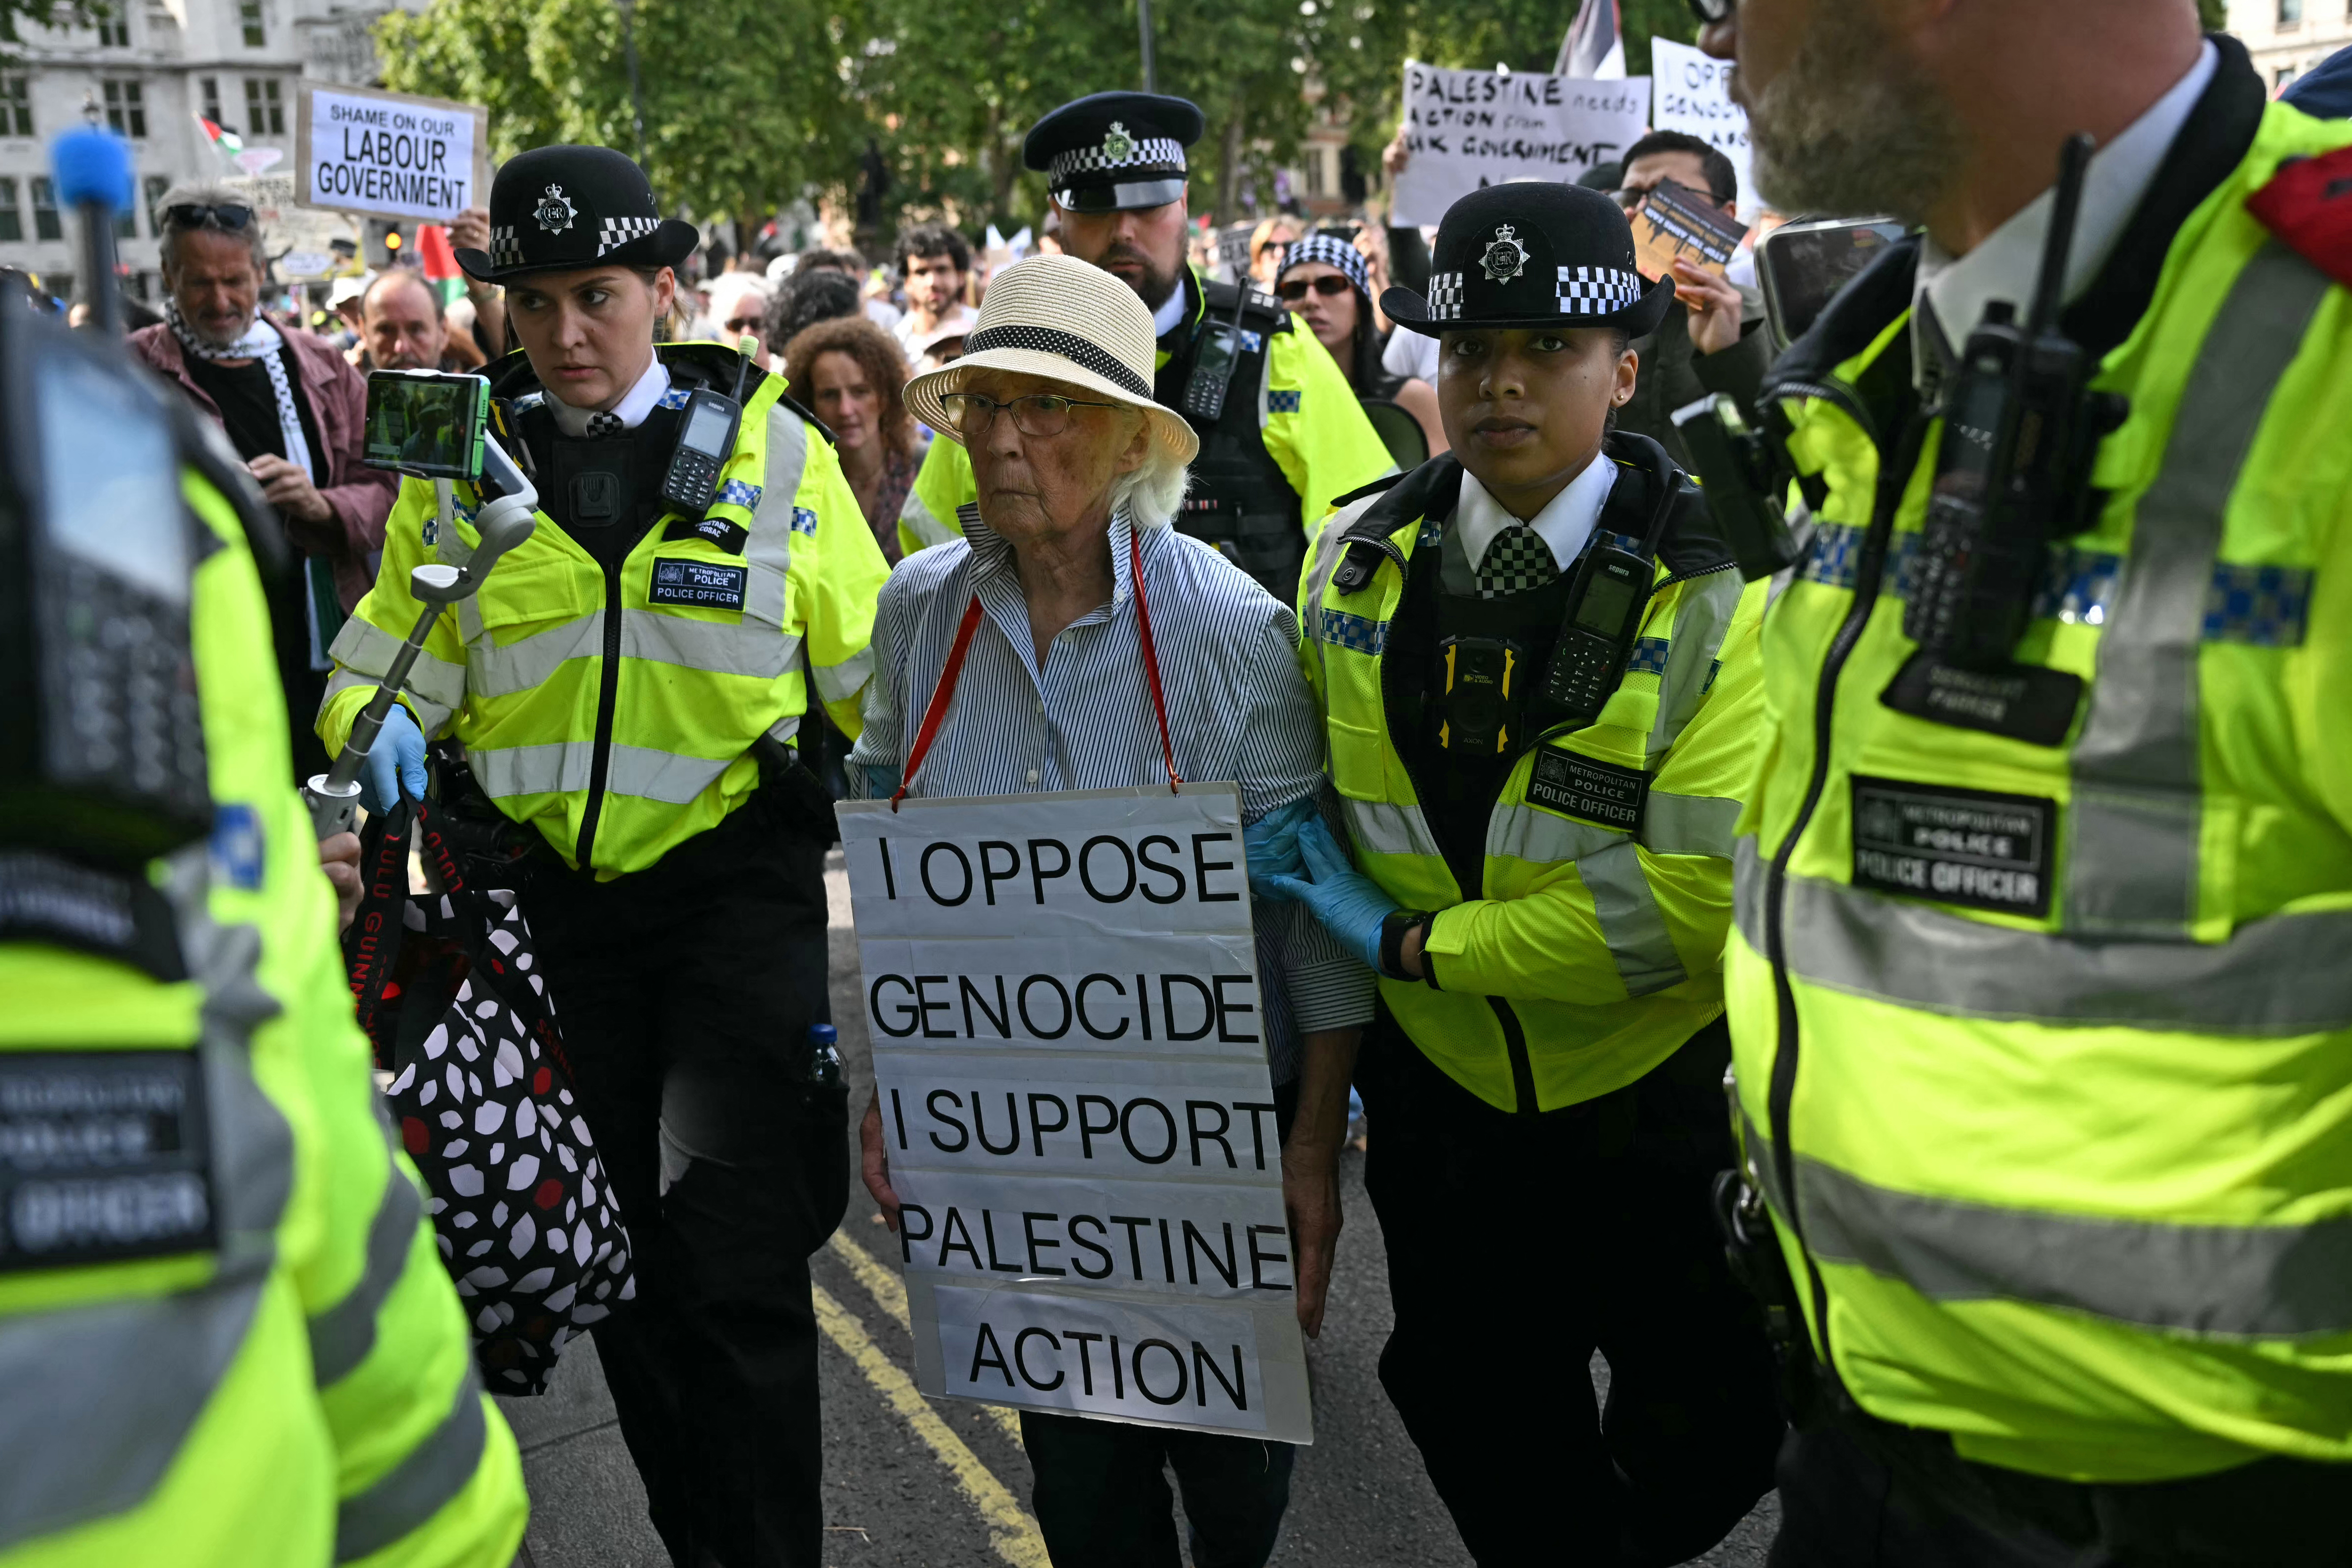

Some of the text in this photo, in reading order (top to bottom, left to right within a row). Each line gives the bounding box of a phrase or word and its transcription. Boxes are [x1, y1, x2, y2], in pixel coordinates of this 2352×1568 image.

[1412, 71, 1637, 114] PALESTINE needs
[330, 104, 455, 136] SHAME ON OUR
[1410, 108, 1495, 128] ACTION
[344, 127, 446, 173] LABOUR
[1462, 137, 1618, 166] GOVERNMENT
[319, 162, 464, 209] GOVERNMENT
[699, 526, 721, 538] COSAC
[689, 568, 736, 579] METROPOLITAN
[695, 575, 729, 586] POLICE
[1608, 564, 1630, 576] sepura
[657, 588, 739, 604] POLICE OFFICER
[1569, 765, 1636, 789] METROPOLITAN
[1574, 779, 1625, 799] POLICE
[1533, 783, 1636, 822] POLICE OFFICER
[1913, 826, 2013, 858] POLICE
[373, 834, 399, 898] LULU
[879, 832, 1240, 907] I OPPOSE
[1931, 860, 2038, 905] OFFICER
[870, 973, 1259, 1043] GENOCIDE
[891, 1088, 1276, 1171] I SUPPORT
[896, 1203, 1293, 1290] PALESTINE
[969, 1322, 1247, 1411] ACTION
